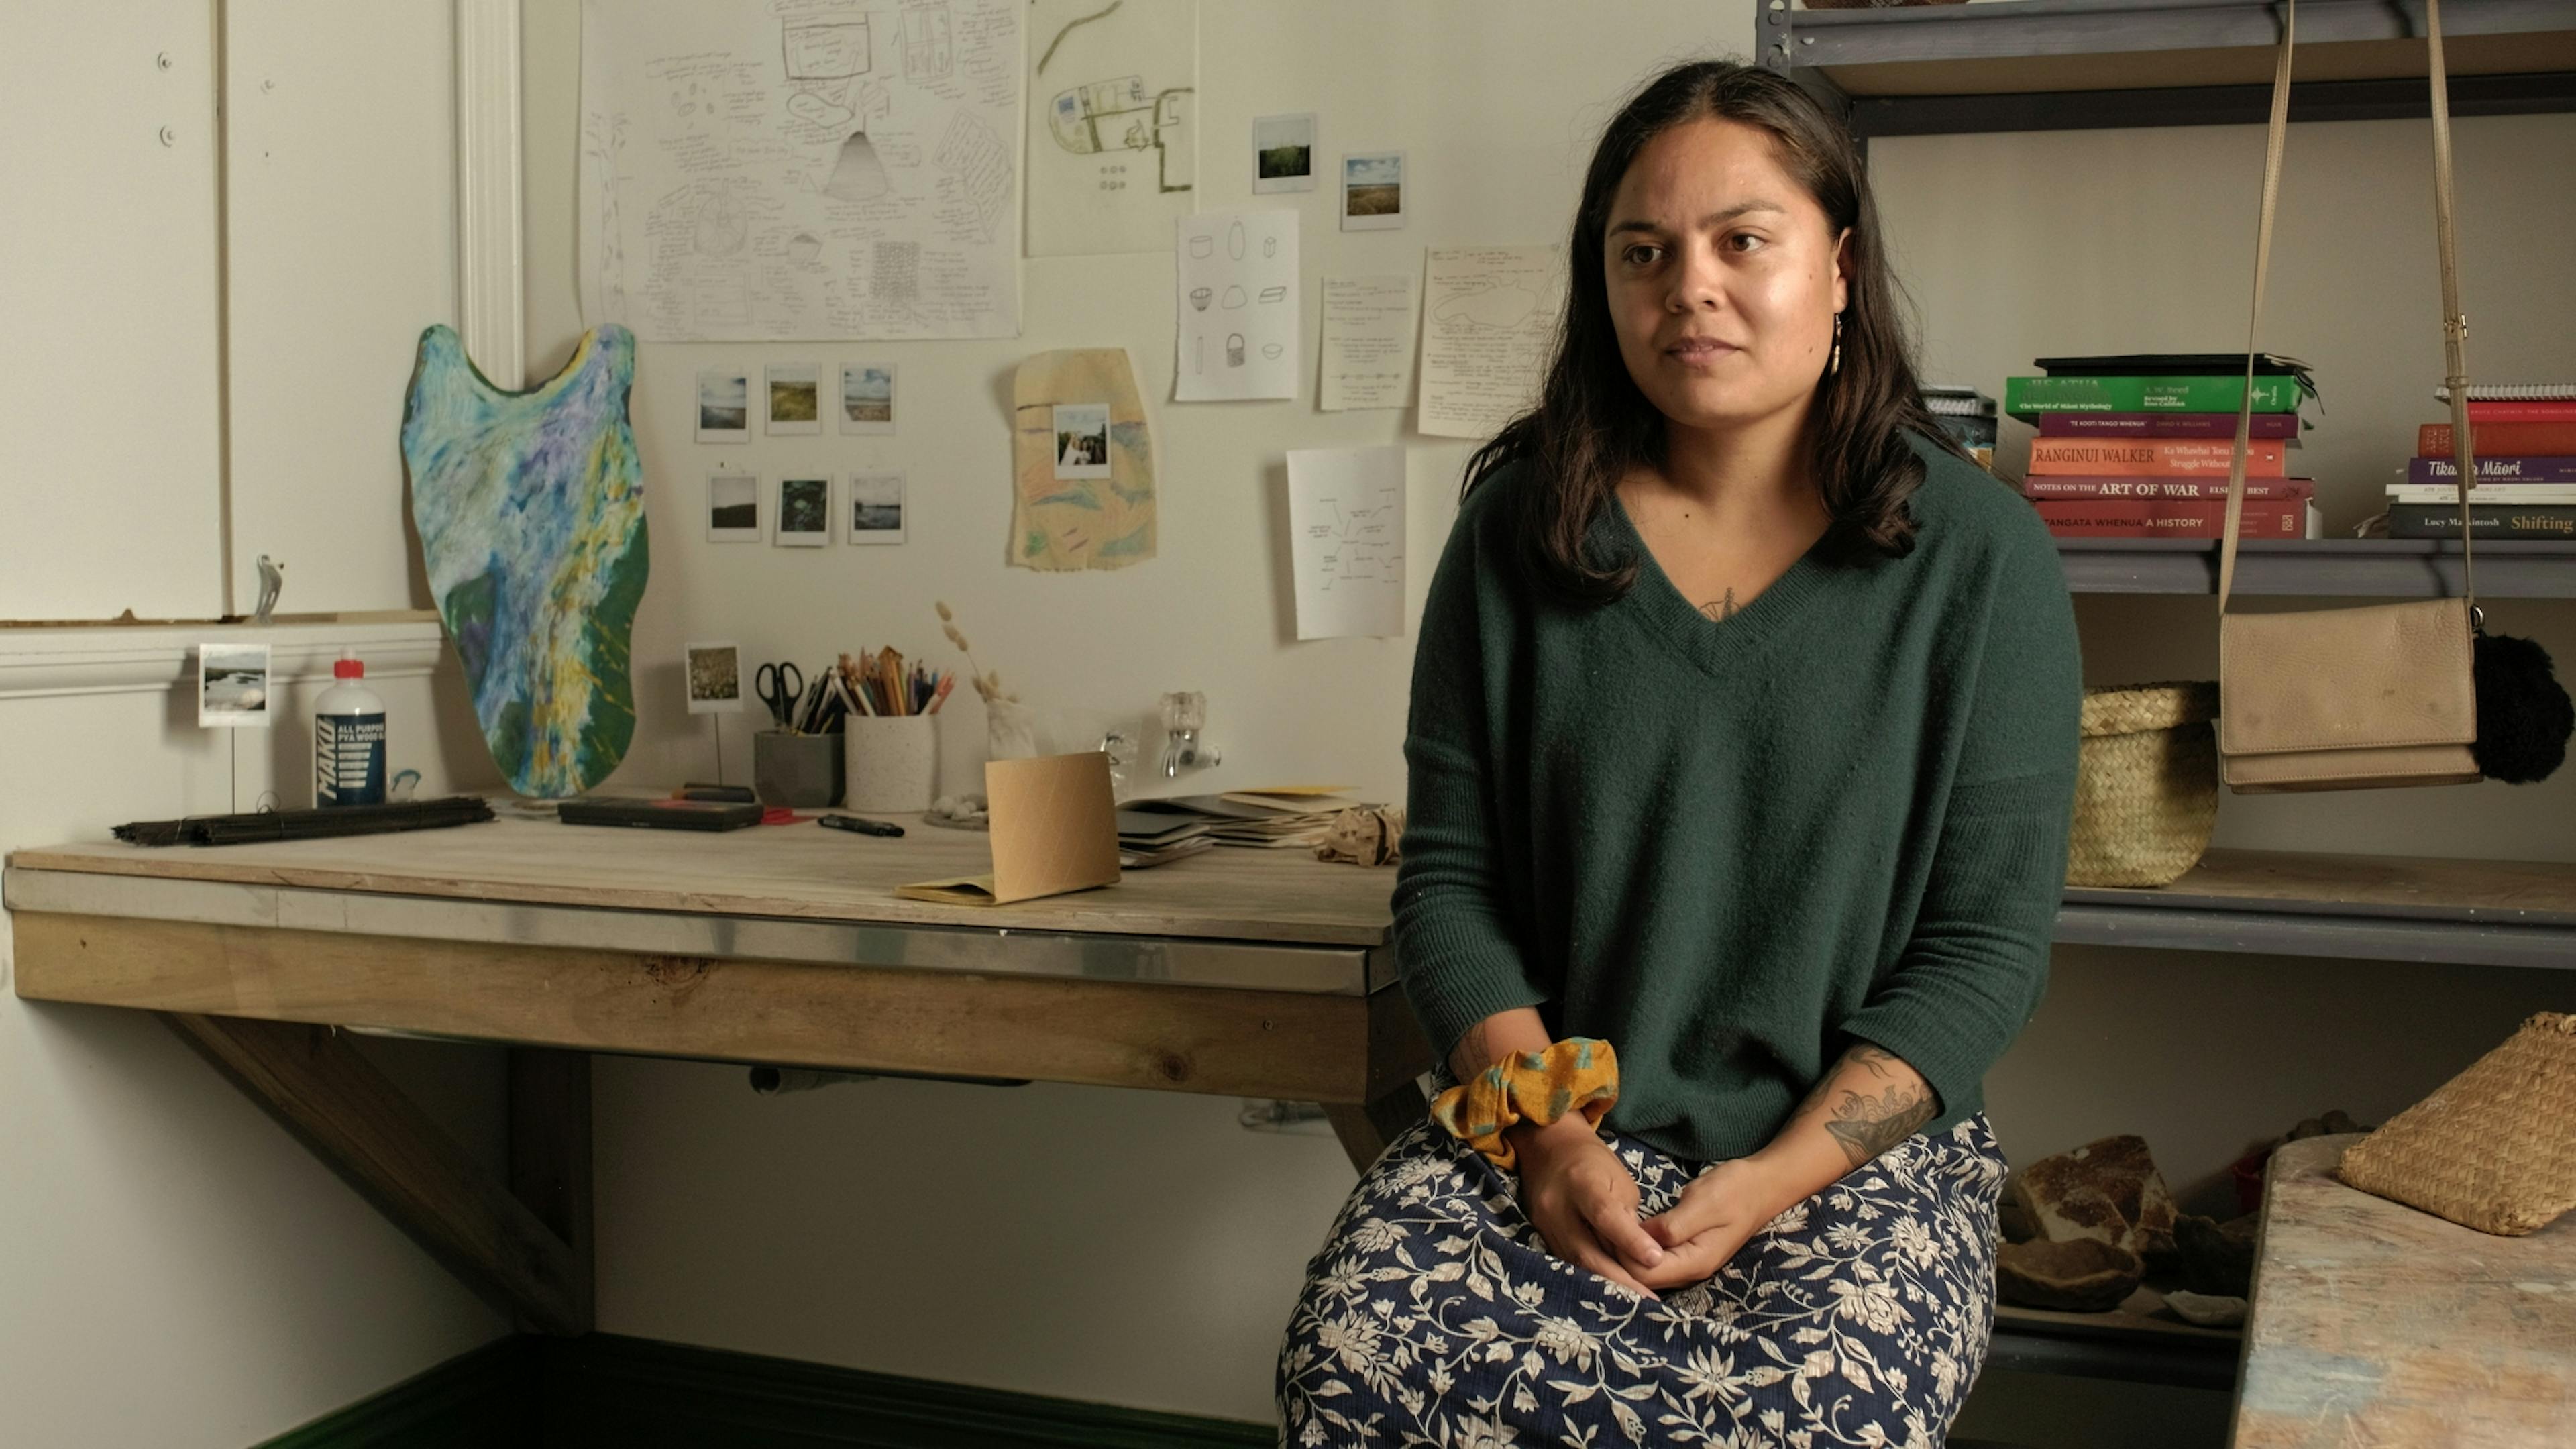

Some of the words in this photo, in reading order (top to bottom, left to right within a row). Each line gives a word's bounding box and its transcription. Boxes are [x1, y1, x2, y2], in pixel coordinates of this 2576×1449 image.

[2080, 402, 2112, 411] Mythology
[2035, 448, 2099, 462] RANGINUI
[2102, 448, 2155, 463] WALKER
[2170, 459, 2200, 470] Struggle
[2201, 459, 2231, 468] Without
[2481, 460, 2522, 476] Māori
[2033, 483, 2061, 492] NOTES
[2063, 484, 2077, 492] ON
[2078, 484, 2096, 492] THE
[2099, 483, 2133, 495] ART
[2136, 483, 2159, 496] OF
[2163, 484, 2200, 497] WAR
[2247, 487, 2270, 495] BEST
[2044, 519, 2092, 527] TANGATA
[2095, 519, 2143, 527] WHENUA
[2145, 519, 2153, 527] A
[2156, 519, 2204, 528] HISTORY
[2424, 517, 2445, 528] Lucy
[2511, 515, 2573, 535] Shifting
[338, 724, 354, 733] ALL
[338, 733, 356, 742] PVA
[317, 717, 338, 800] MAKO
